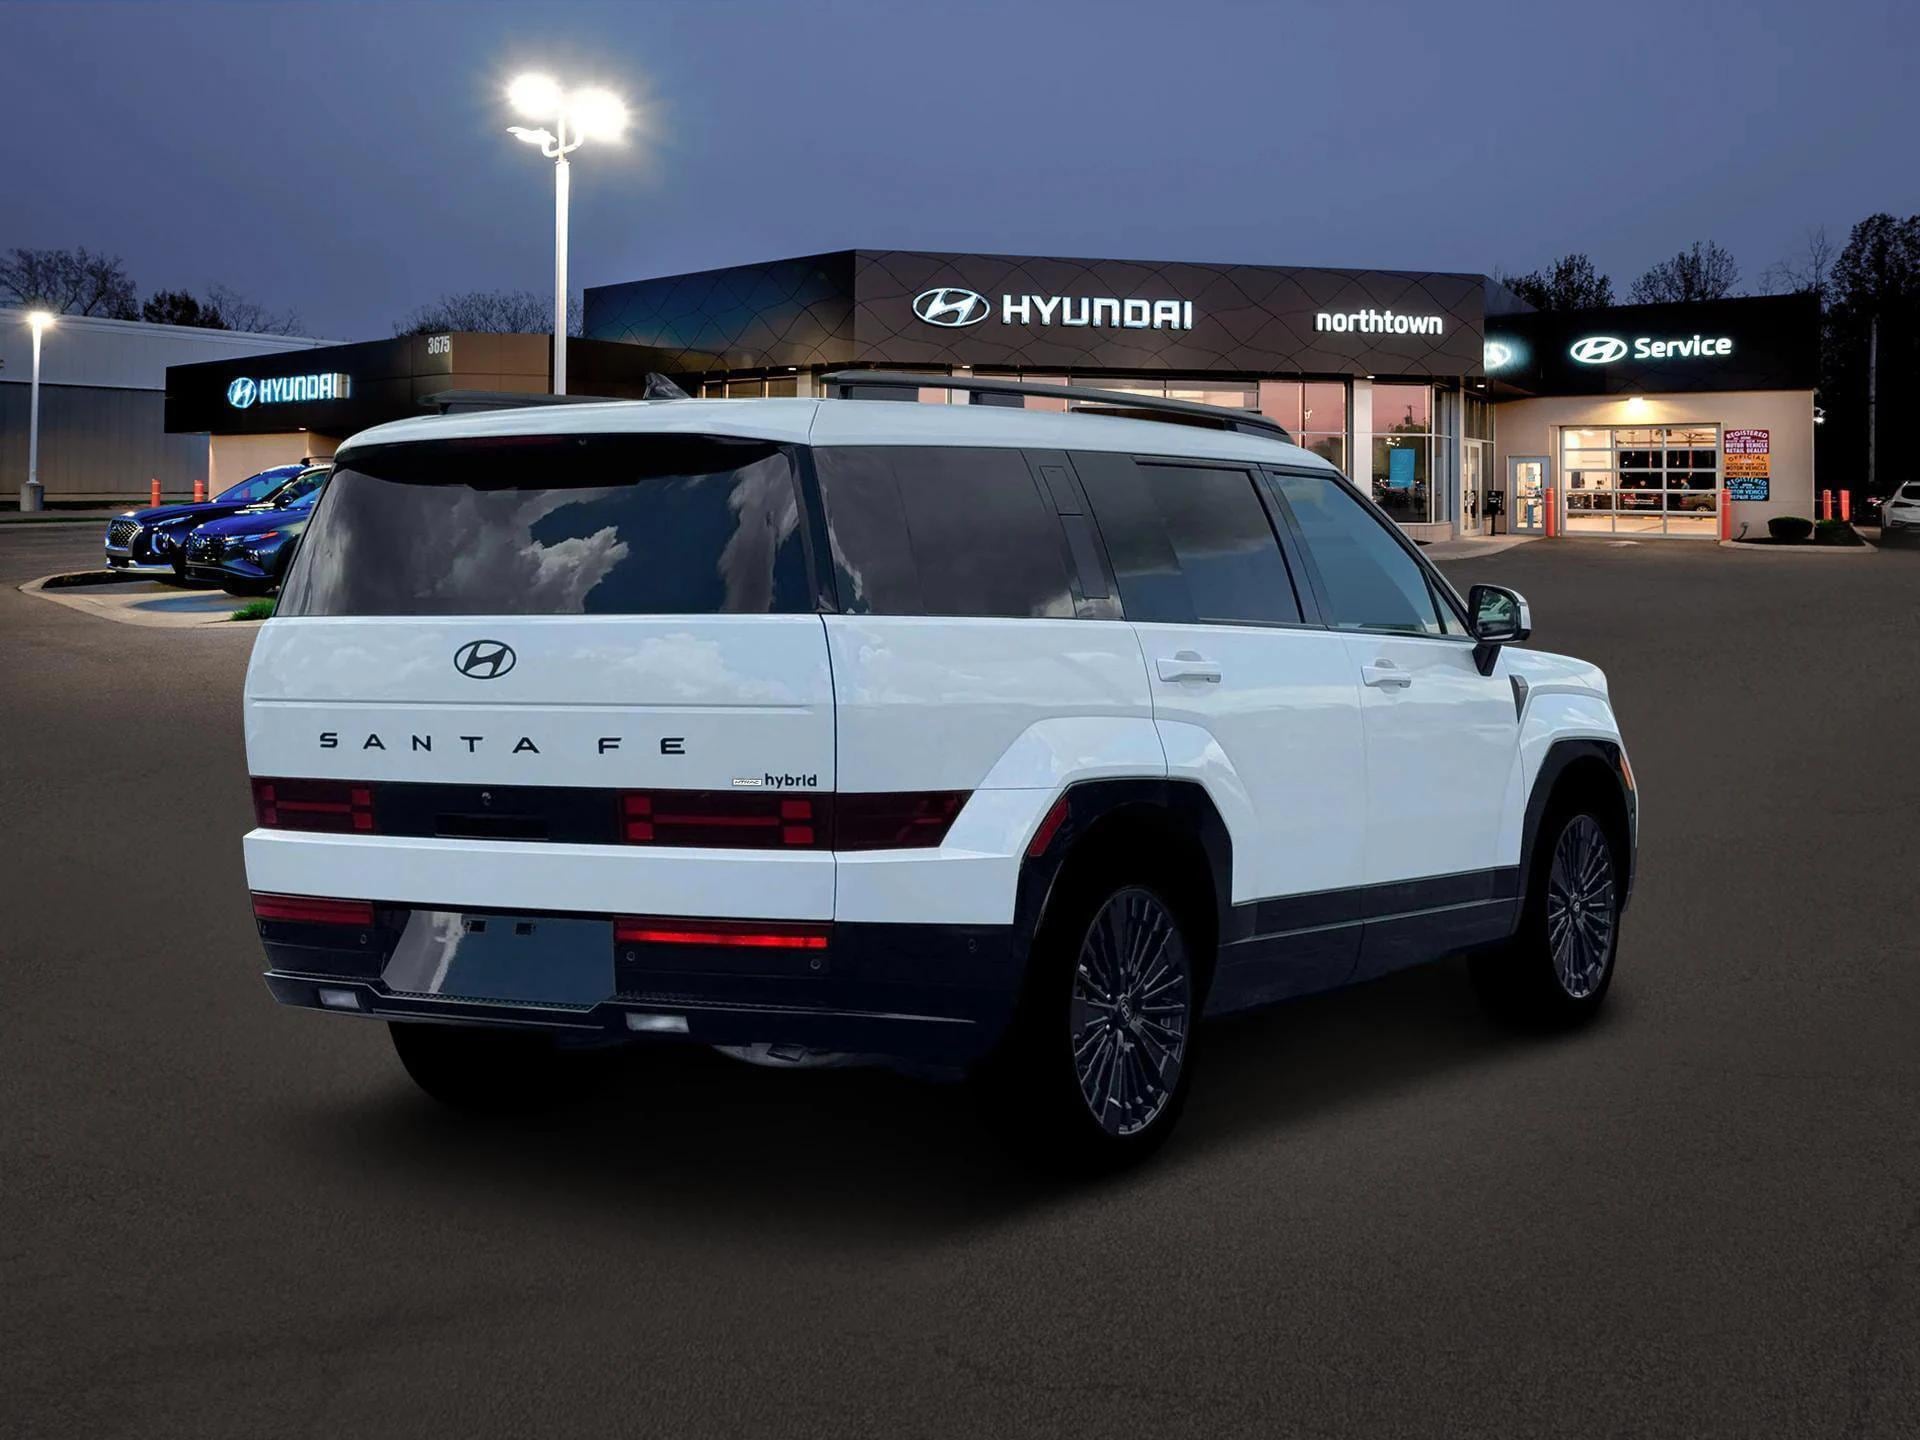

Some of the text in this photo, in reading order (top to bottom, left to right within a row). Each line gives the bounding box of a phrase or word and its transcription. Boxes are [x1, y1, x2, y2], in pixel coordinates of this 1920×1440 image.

[1002, 294, 1193, 330] HYUNDAI
[1316, 309, 1443, 335] northtown
[427, 335, 450, 355] 3675
[1634, 335, 1733, 359] Service
[260, 373, 338, 403] HYUNDAI
[1726, 430, 1768, 439] REGISTERED
[1726, 477, 1768, 486] REGISTERED
[319, 732, 686, 755] SANTA FE
[765, 773, 817, 788] hybrid
